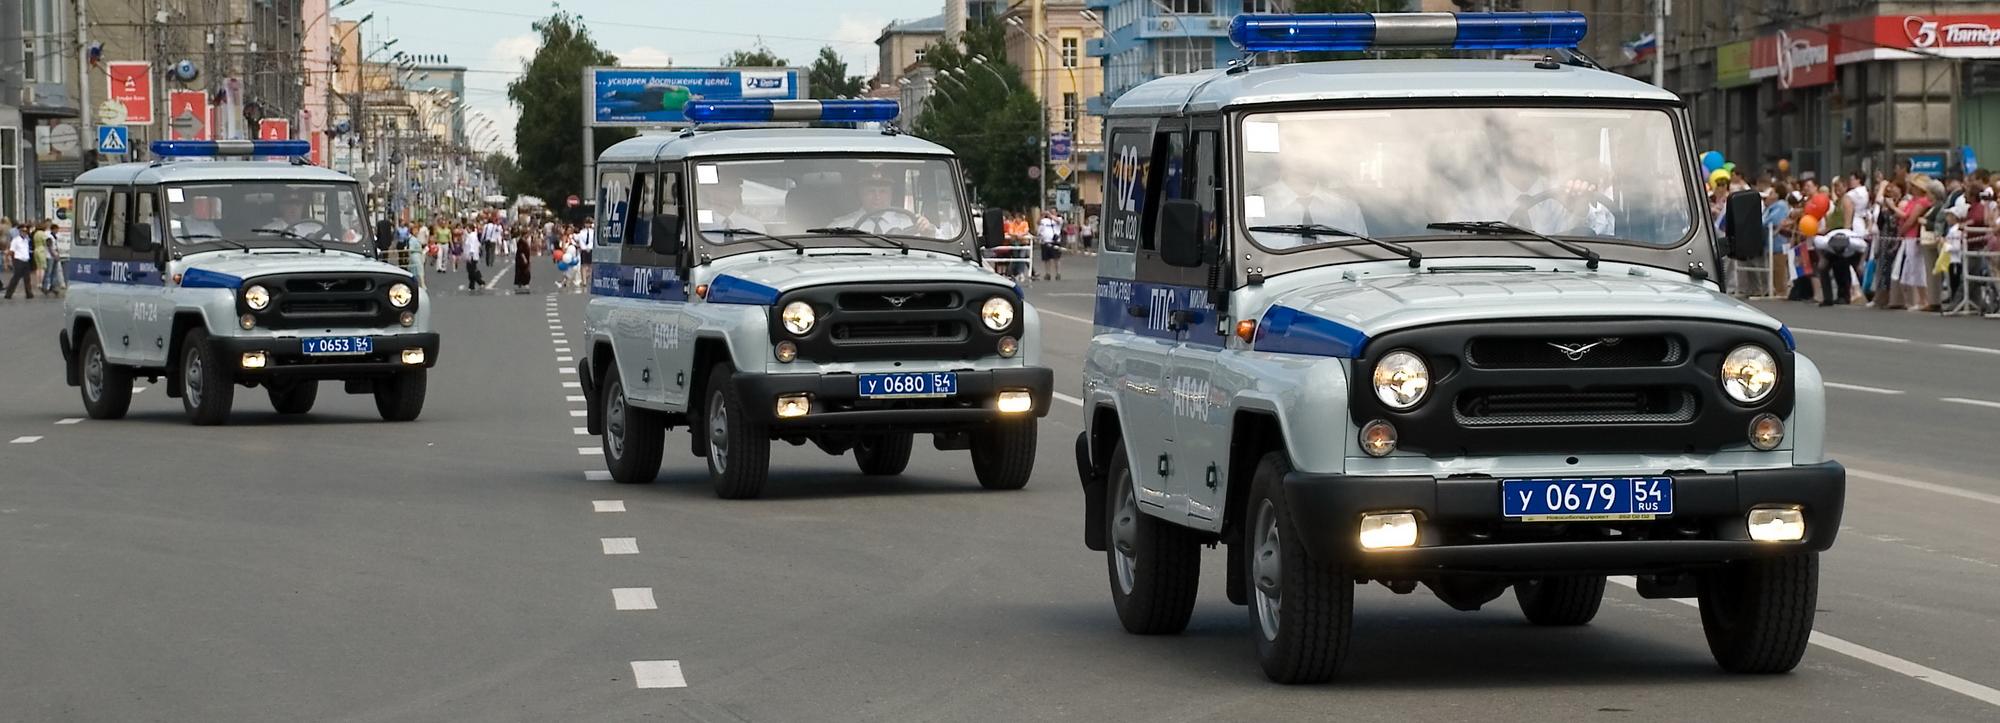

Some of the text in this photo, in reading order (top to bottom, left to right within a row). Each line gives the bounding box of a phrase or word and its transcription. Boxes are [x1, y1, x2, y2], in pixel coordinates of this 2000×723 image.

[1913, 21, 1938, 47] 5
[608, 77, 647, 87] ускоряем
[1118, 145, 1138, 212] 02
[83, 196, 98, 227] 02
[606, 180, 620, 221] 02
[1125, 214, 1138, 240] 020
[111, 261, 129, 282] ППС
[632, 268, 652, 295] ППС
[1148, 288, 1175, 332] ППС
[320, 339, 349, 352] 0653
[356, 338, 368, 348] 54
[884, 376, 925, 393] 0680
[934, 374, 950, 387] 54
[1546, 483, 1616, 511] 0679
[1634, 480, 1661, 502] 54
[1638, 502, 1658, 511] RUS
